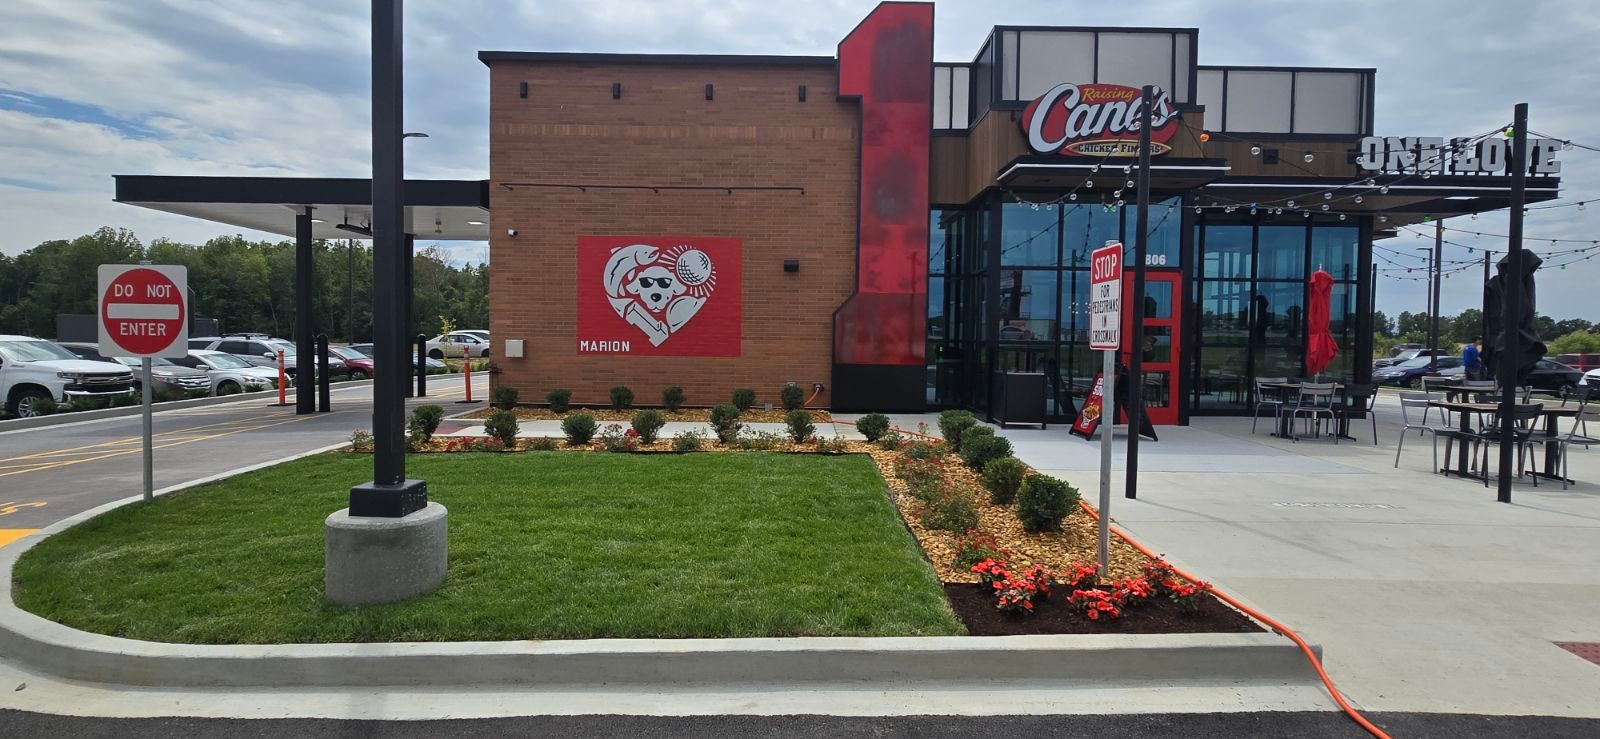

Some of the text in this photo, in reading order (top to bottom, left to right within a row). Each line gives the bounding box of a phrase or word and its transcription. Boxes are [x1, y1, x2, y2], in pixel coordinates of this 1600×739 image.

[1082, 86, 1134, 103] Raising
[1359, 136, 1443, 171] ONE
[1095, 254, 1117, 279] STOP
[114, 284, 172, 298] DO NOT
[1101, 284, 1110, 298] FOR
[1092, 299, 1118, 314] PEDESTRIANS
[1102, 315, 1107, 328] IN
[120, 322, 167, 337] ENTER
[1092, 330, 1117, 343] CROSSWALK
[580, 340, 630, 352] MARION
